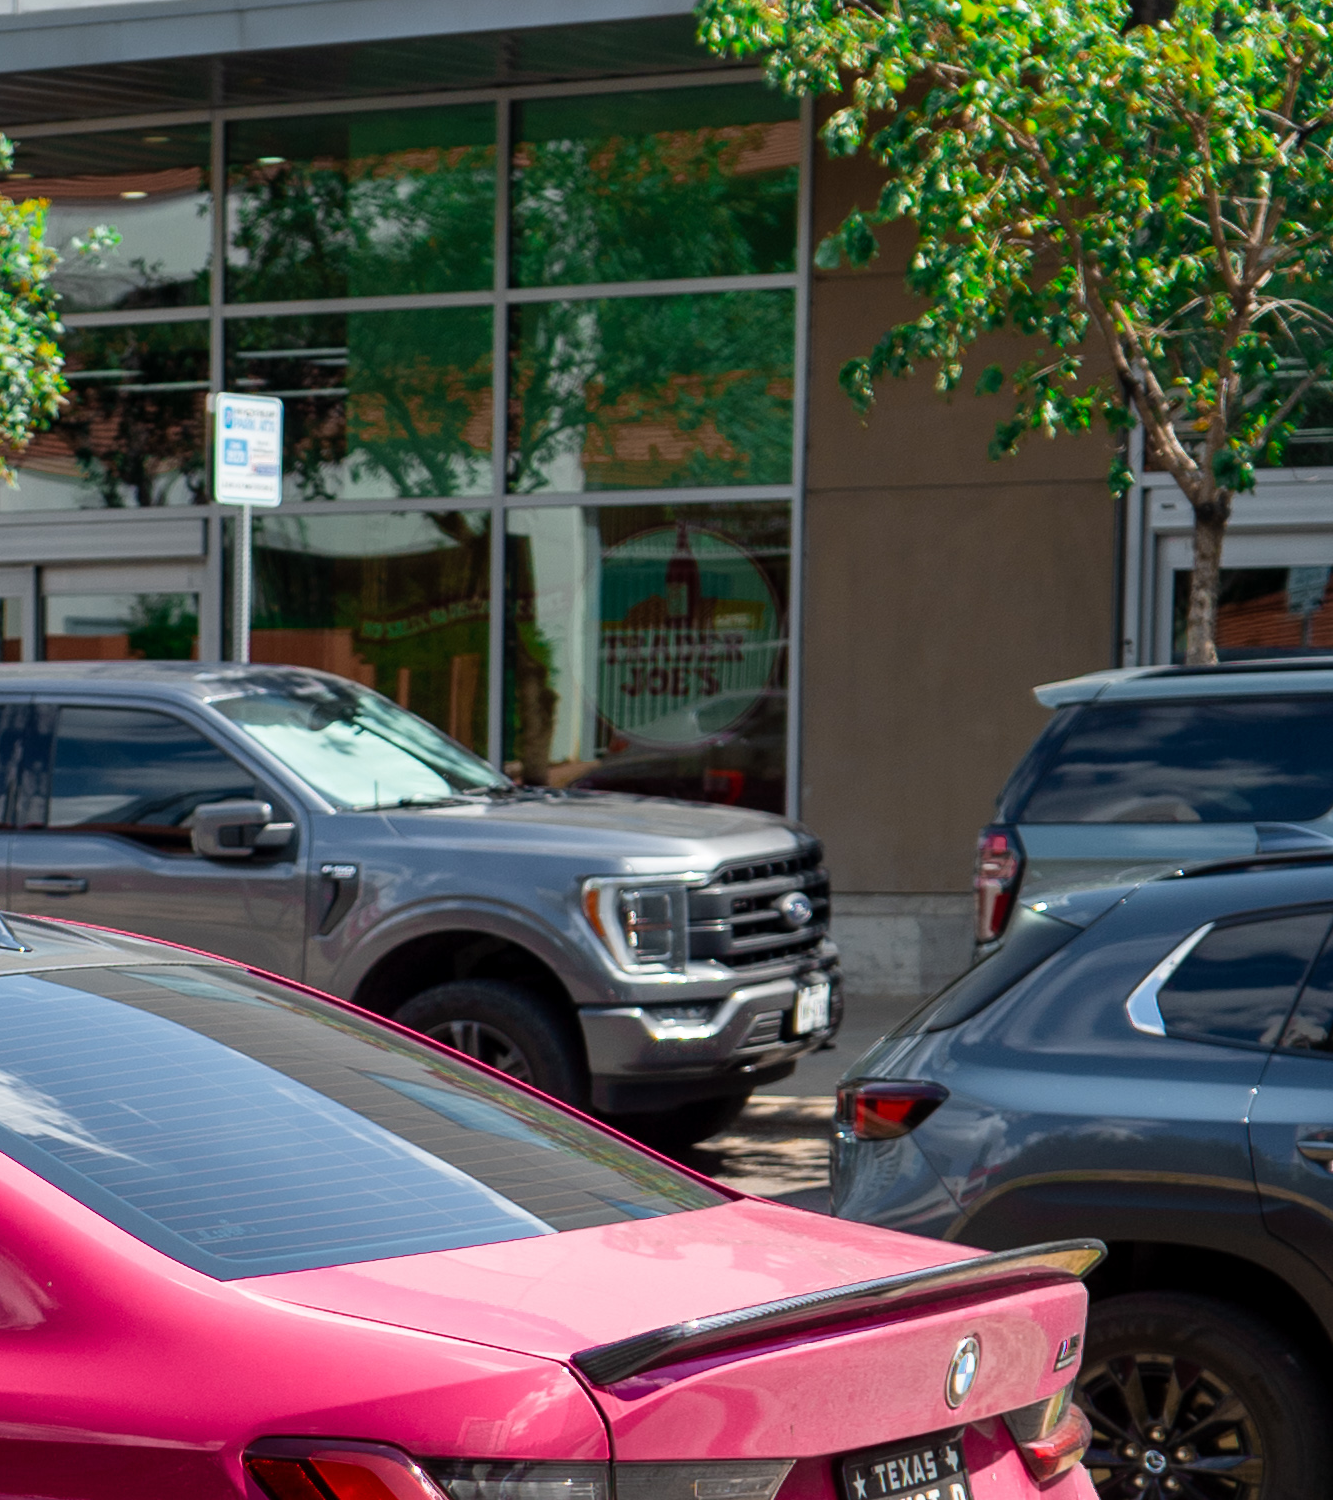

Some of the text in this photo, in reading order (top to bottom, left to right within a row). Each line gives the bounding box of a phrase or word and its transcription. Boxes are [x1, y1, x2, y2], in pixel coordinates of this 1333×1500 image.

[605, 633, 744, 665] TRADER
[621, 666, 720, 697] JOE'S
[873, 1451, 938, 1493] TEXAS
